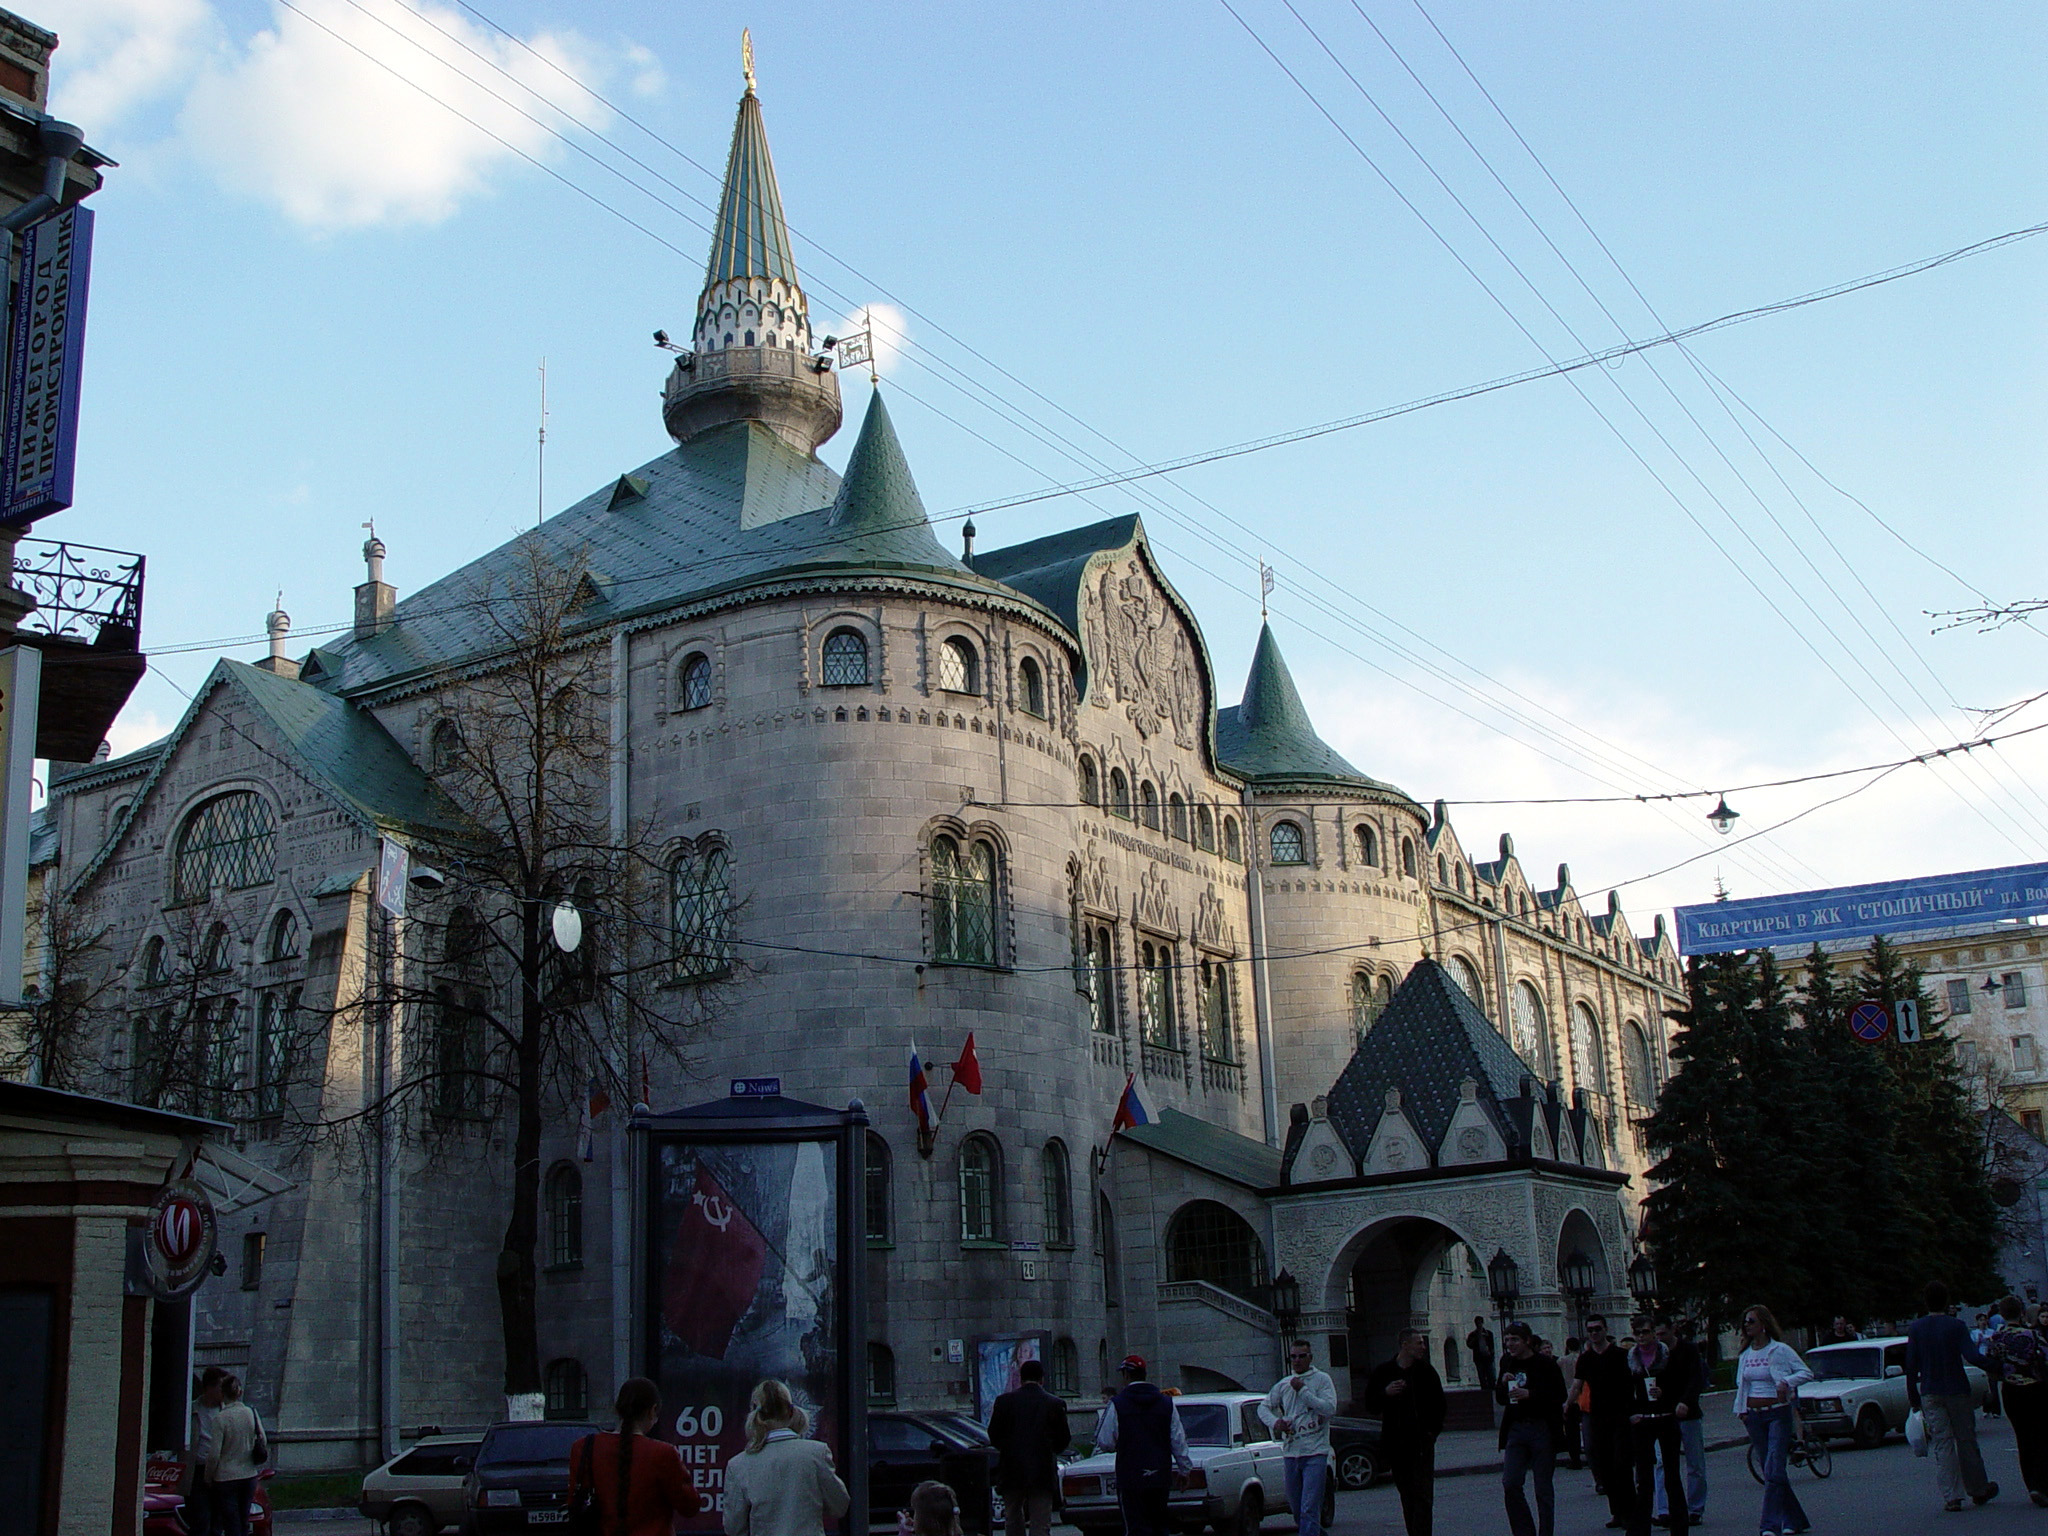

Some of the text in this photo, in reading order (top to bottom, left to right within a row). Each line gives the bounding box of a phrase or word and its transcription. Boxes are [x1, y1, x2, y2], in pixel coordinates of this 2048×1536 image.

[39, 210, 73, 475] ПРОМСТРОЙБАНК
[20, 257, 54, 483] НИЖЕГОРОД
[1698, 915, 1791, 938] КВАРТИРЫ
[1797, 913, 1807, 928] В
[1811, 907, 1842, 925] ЖК
[1848, 887, 1994, 920] "СТОЛИЧНЫЙ"
[2000, 891, 2020, 904] НА
[1024, 1263, 1033, 1277] 26
[676, 1406, 723, 1437] 60
[677, 1444, 720, 1464] ЛЕТ
